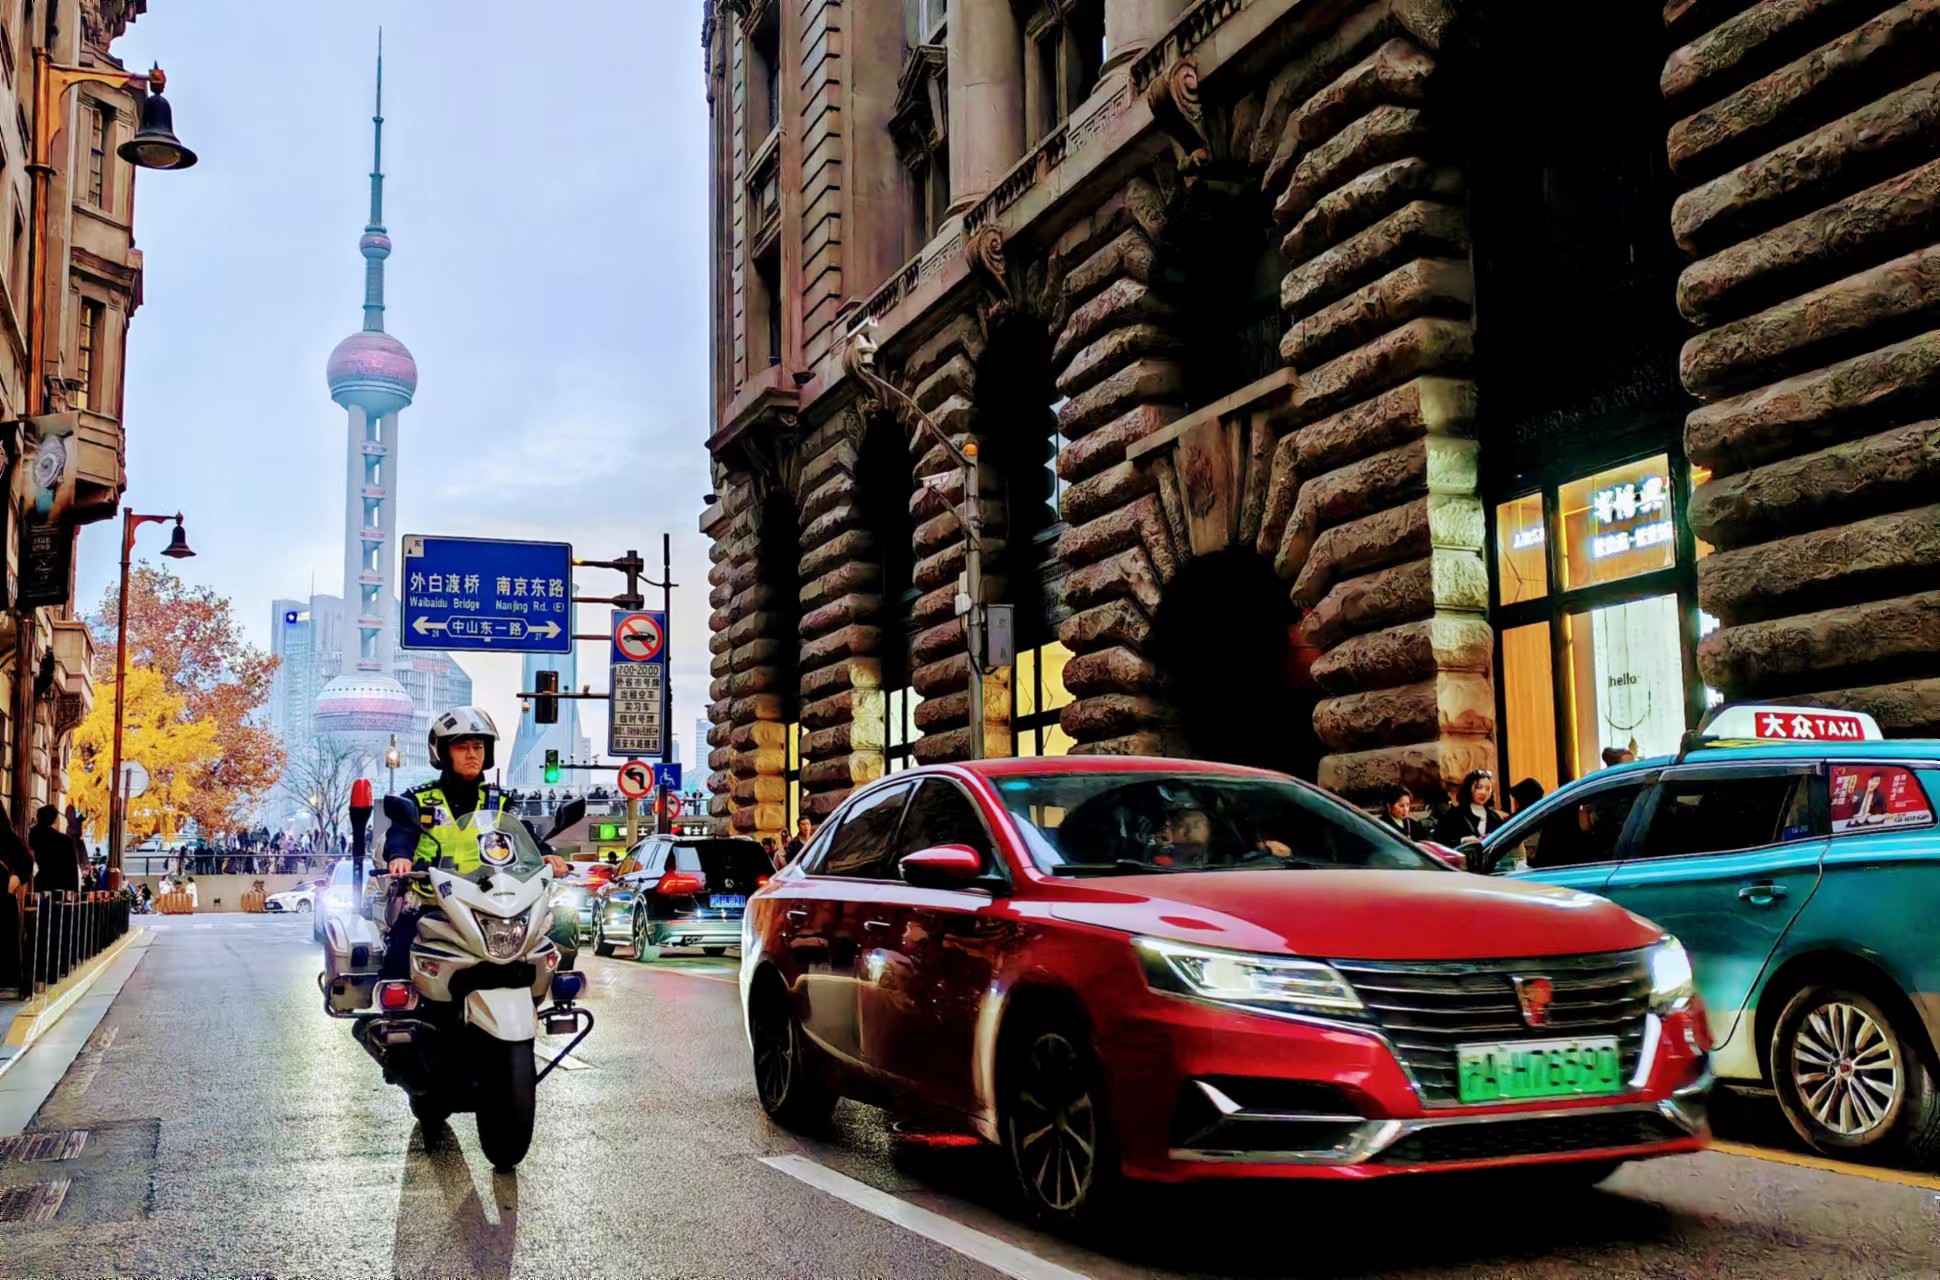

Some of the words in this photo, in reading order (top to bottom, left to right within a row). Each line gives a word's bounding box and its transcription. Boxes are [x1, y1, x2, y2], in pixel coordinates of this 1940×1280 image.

[410, 572, 480, 595] 外白渡桥
[496, 576, 564, 598] 南京东路
[410, 596, 448, 608] Waibaidu
[453, 598, 480, 611] Bridge
[496, 600, 528, 613] Nanjing
[533, 601, 548, 612] Rd.
[553, 602, 565, 612] (E)
[452, 619, 521, 636] 中山东一路
[616, 678, 660, 687] 外省市号牌
[1608, 672, 1637, 687] hello
[620, 690, 655, 699] 出租空车
[624, 702, 650, 711] 实习车
[1762, 713, 1815, 739] 大众
[1815, 719, 1858, 737] TAXI
